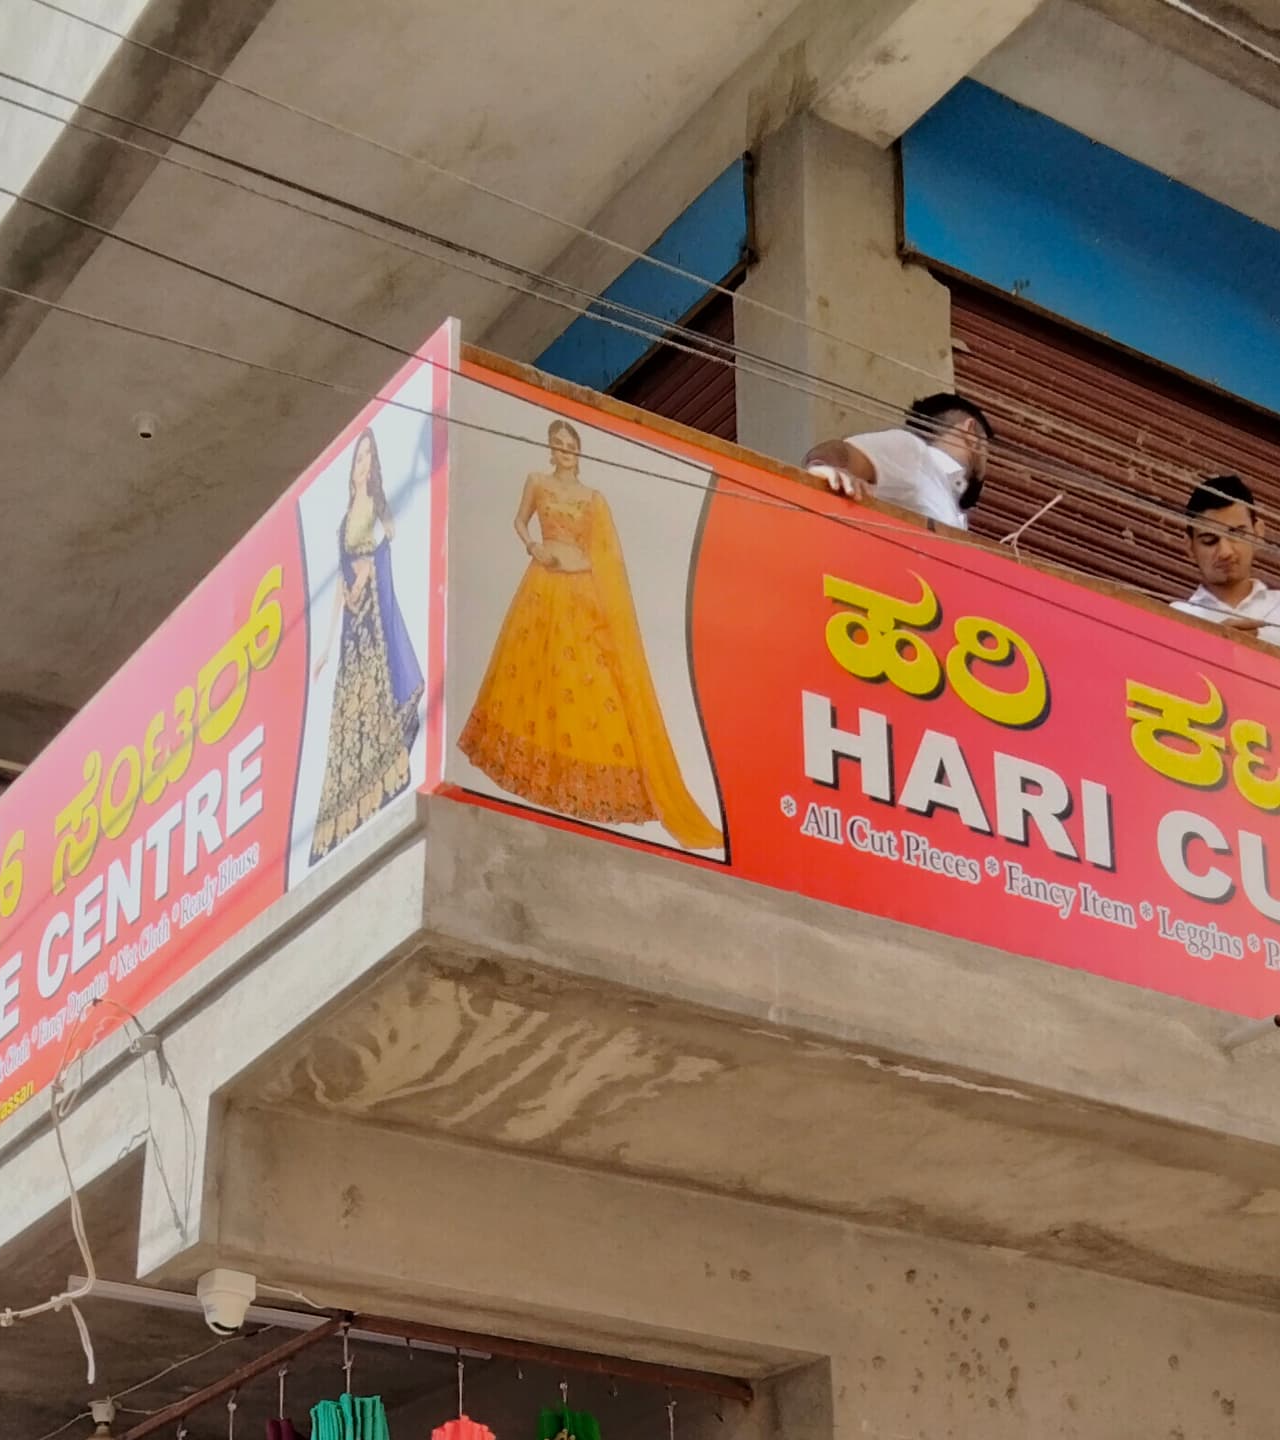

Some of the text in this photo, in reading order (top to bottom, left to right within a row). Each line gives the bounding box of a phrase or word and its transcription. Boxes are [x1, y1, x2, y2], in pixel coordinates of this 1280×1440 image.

[52, 564, 282, 896] ಸೆಂಟರ್
[822, 568, 1050, 727] ಹರಿ
[37, 724, 264, 999] CENTRE
[801, 690, 1115, 870] HARI
[217, 841, 261, 897] Blouse
[801, 805, 843, 843] All
[847, 818, 898, 858] Cut
[902, 829, 980, 884] Pieces
[1005, 860, 1075, 919] Fancy
[1078, 882, 1137, 929] Item
[1158, 908, 1244, 960] Leggins
